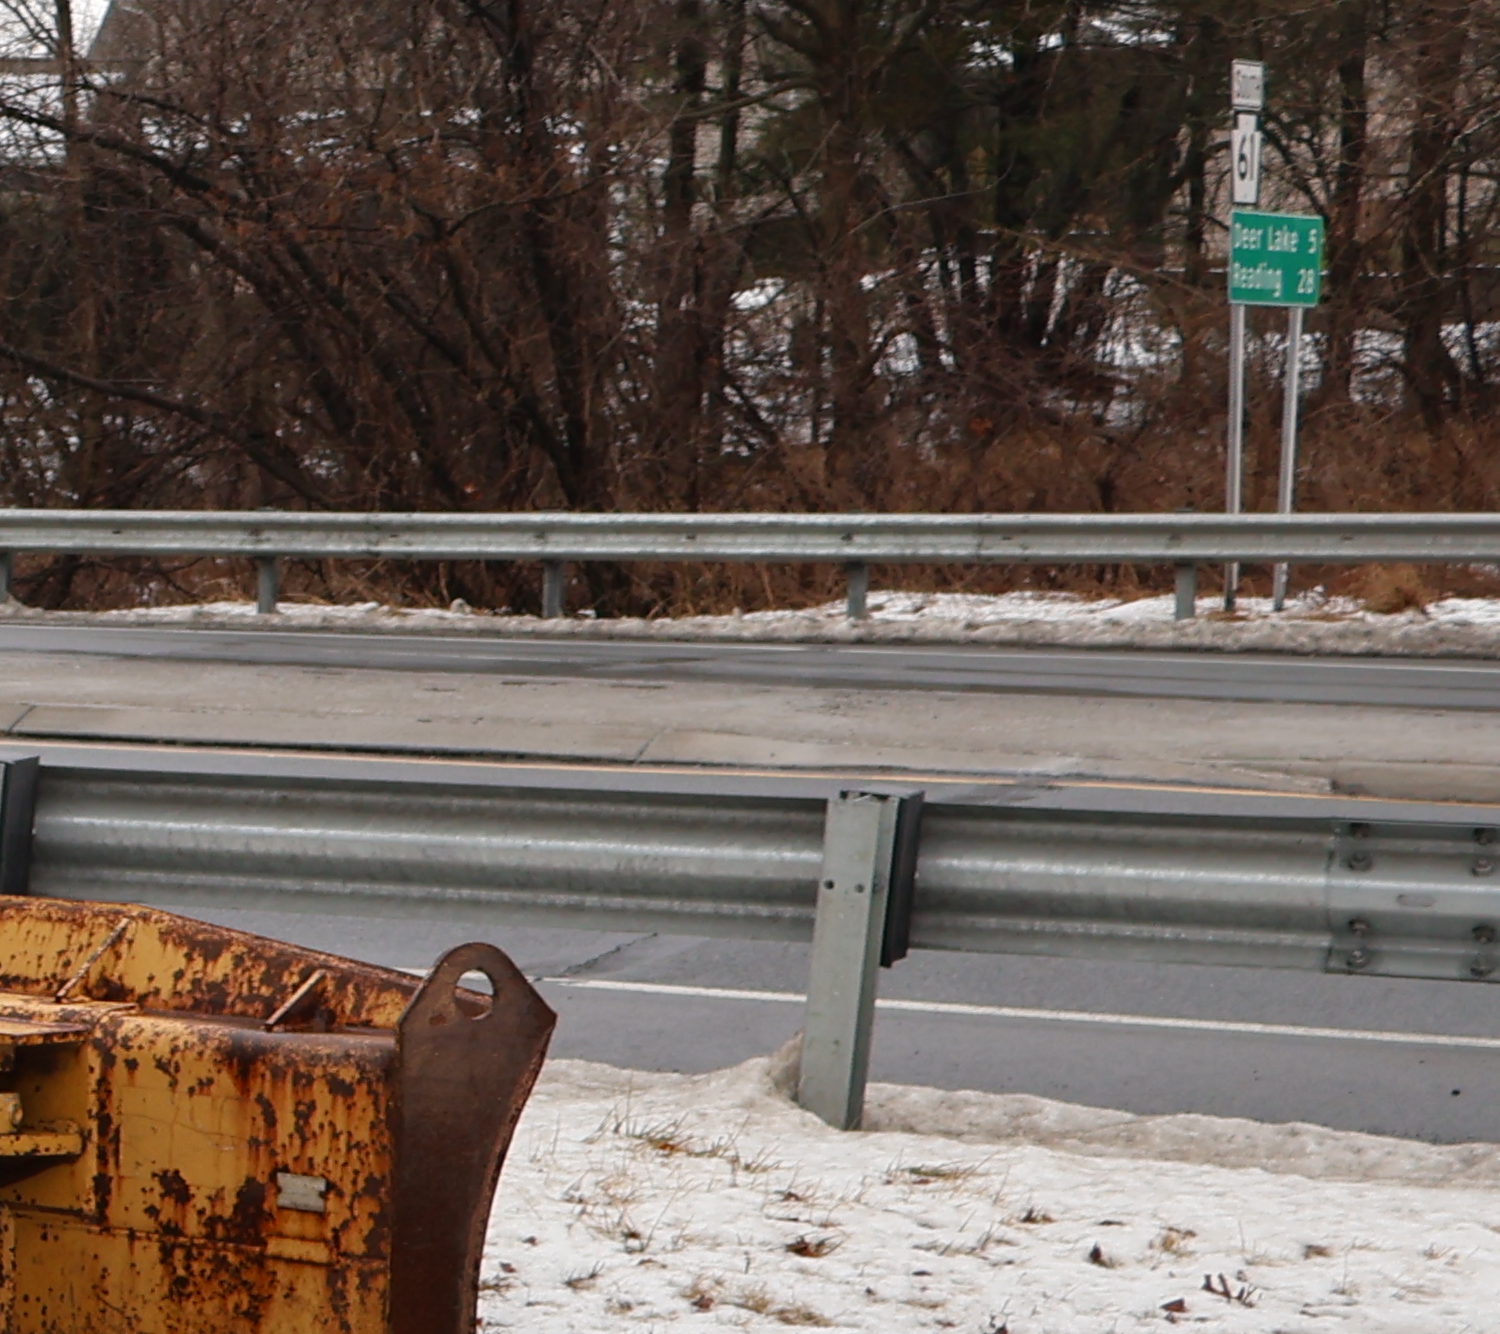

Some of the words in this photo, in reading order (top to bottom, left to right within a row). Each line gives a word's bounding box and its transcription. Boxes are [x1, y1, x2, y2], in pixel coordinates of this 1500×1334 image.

[1238, 134, 1254, 181] 61
[1232, 223, 1263, 249] Deer
[1267, 224, 1298, 252] Lake
[1308, 229, 1317, 254] 5
[1232, 262, 1282, 298] Reading
[1296, 268, 1314, 294] 28
